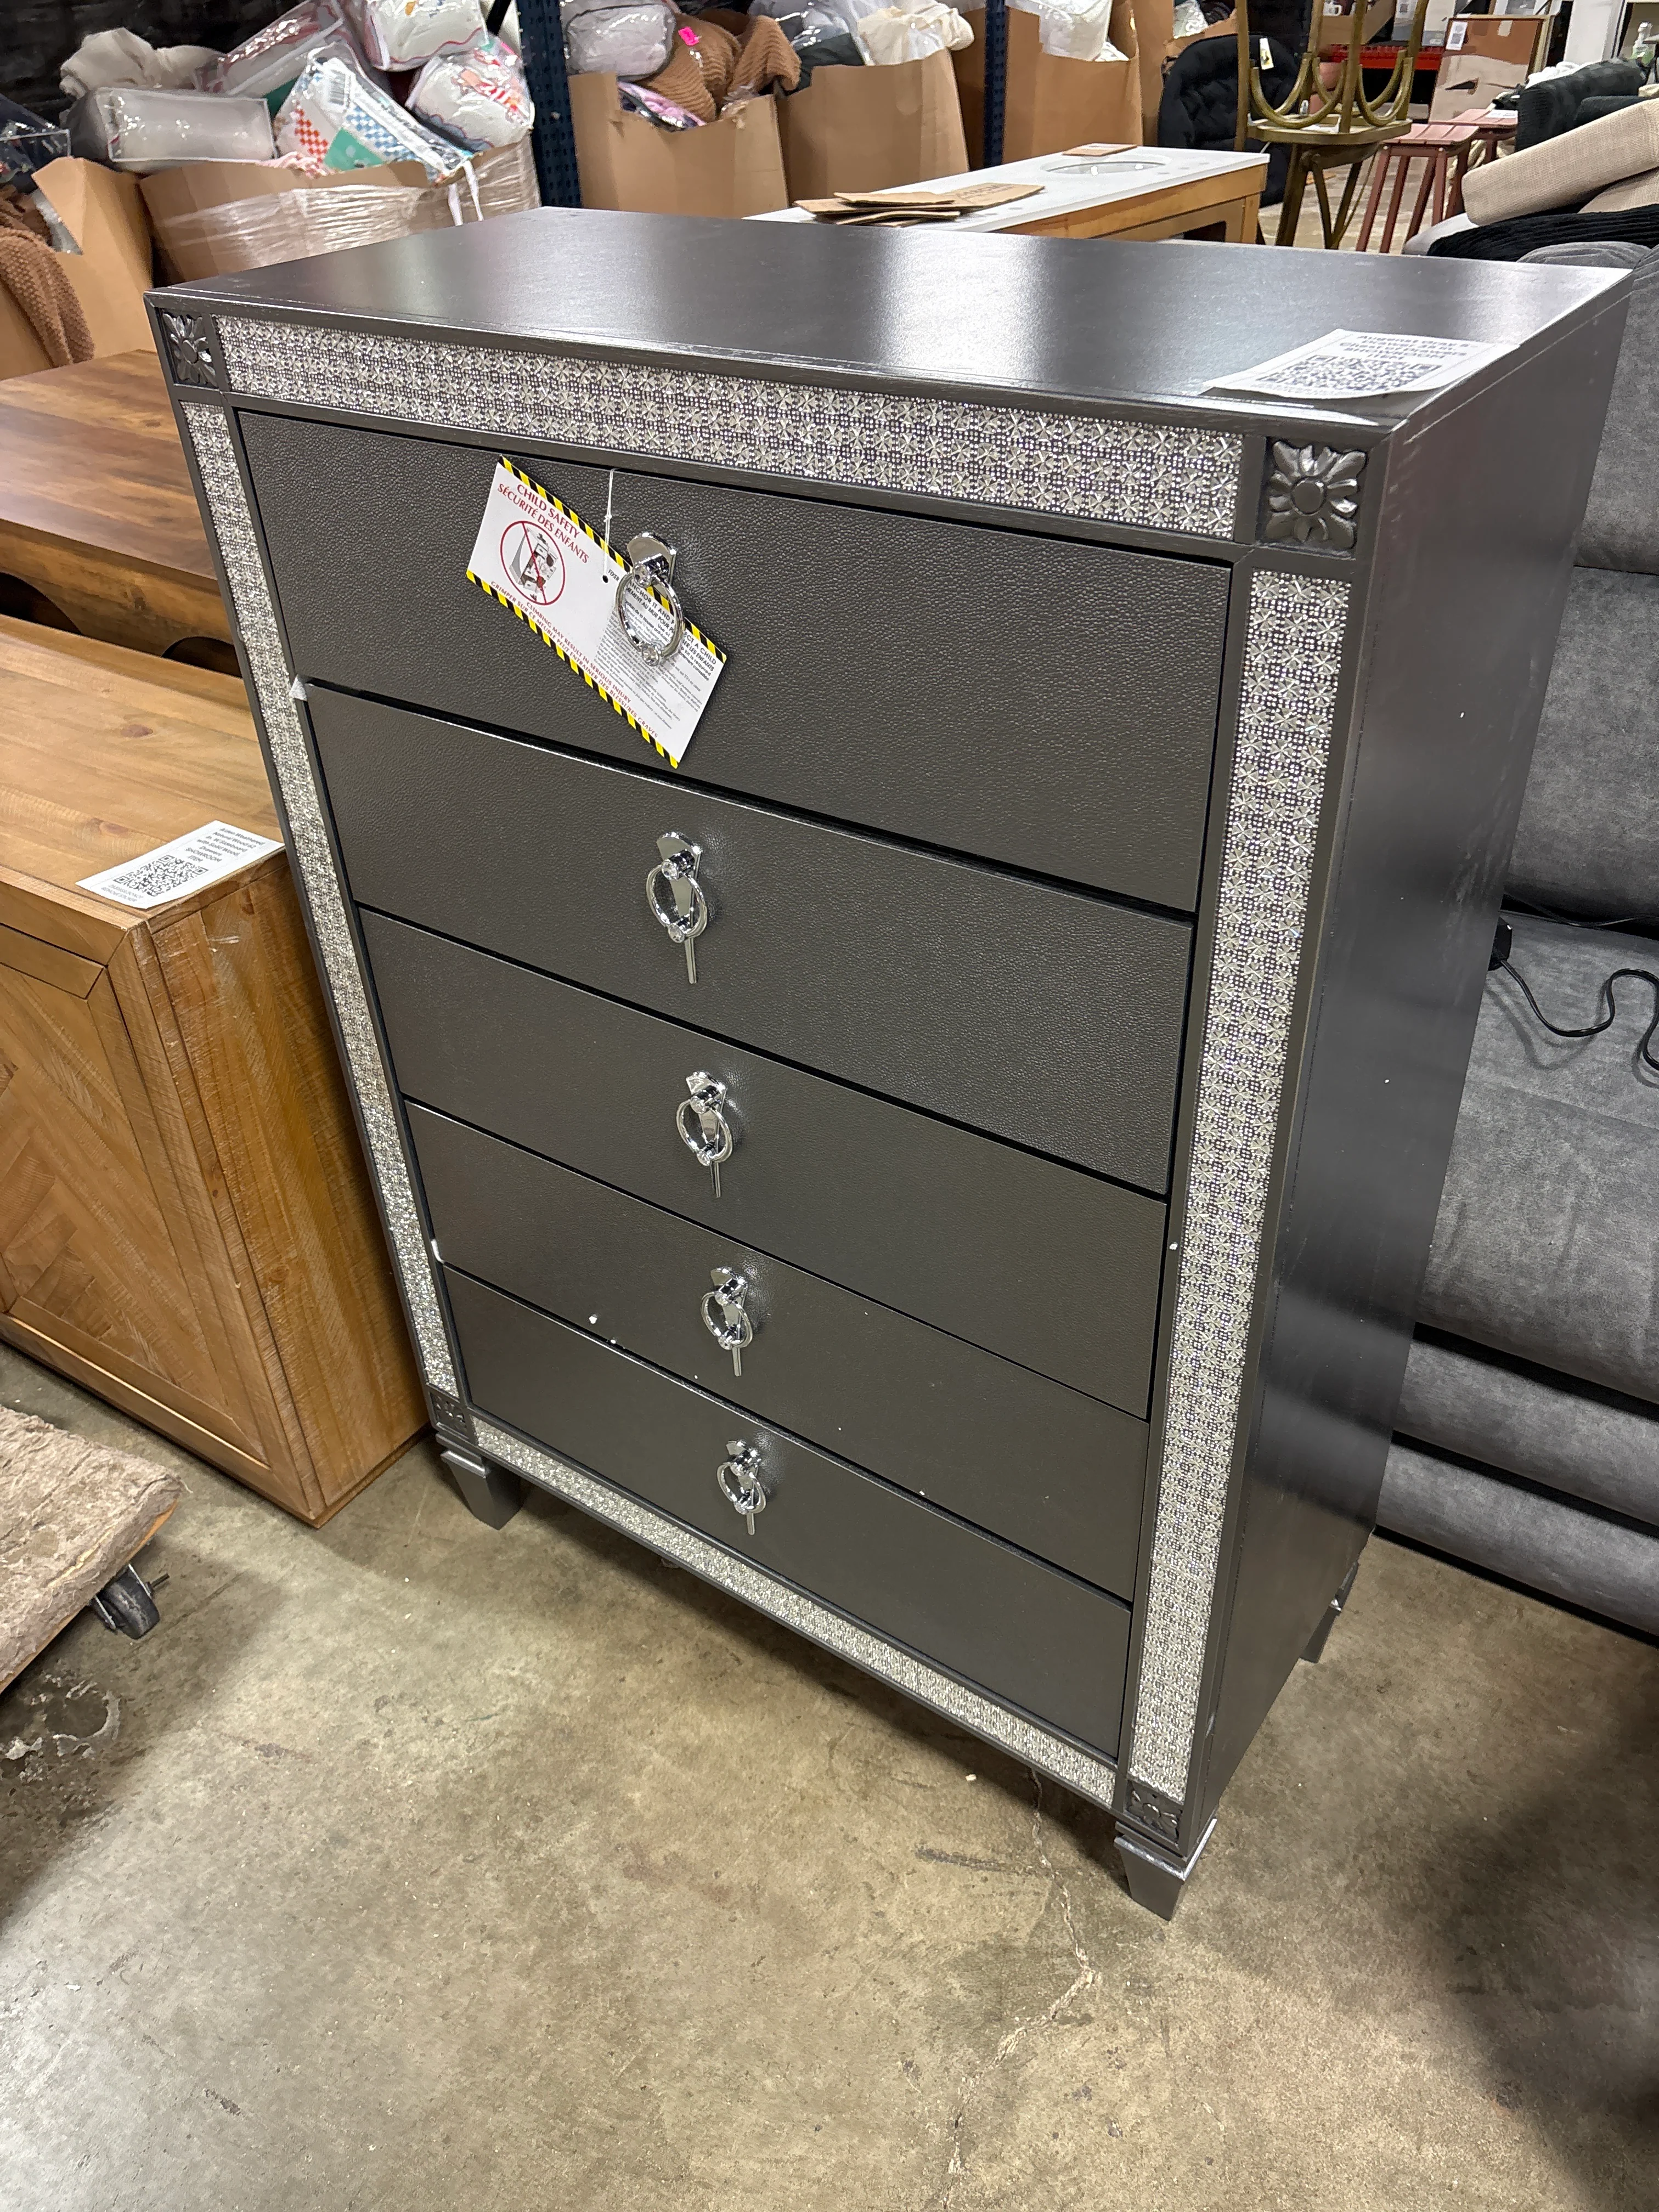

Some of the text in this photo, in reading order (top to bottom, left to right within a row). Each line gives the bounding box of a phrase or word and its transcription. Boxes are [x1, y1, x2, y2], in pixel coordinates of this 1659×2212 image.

[498, 484, 589, 563] SÉCURITÉ DES ENFANTS
[517, 484, 580, 538] CHILD SAFETY
[527, 602, 551, 628] CLIMBING
[552, 627, 564, 639] MAY
[565, 638, 582, 657] RESULT
[590, 663, 612, 685] SERIOUS
[612, 685, 631, 703] INJURY
[608, 569, 619, 582] FIXER
[648, 607, 658, 617] MUR
[658, 616, 669, 629] POUR
[696, 653, 714, 671] ENFANTS
[658, 608, 670, 620] AND
[700, 648, 716, 664] CHILD
[491, 582, 516, 603] GRIMPER
[518, 601, 528, 612] SUR
[537, 619, 556, 639] MEUBLE
[557, 639, 569, 652] PEUT
[599, 679, 609, 690] DES
[610, 690, 637, 718] BLESSURES
[637, 718, 658, 738] GRAVES
[185, 848, 222, 862] SHOWROOM
